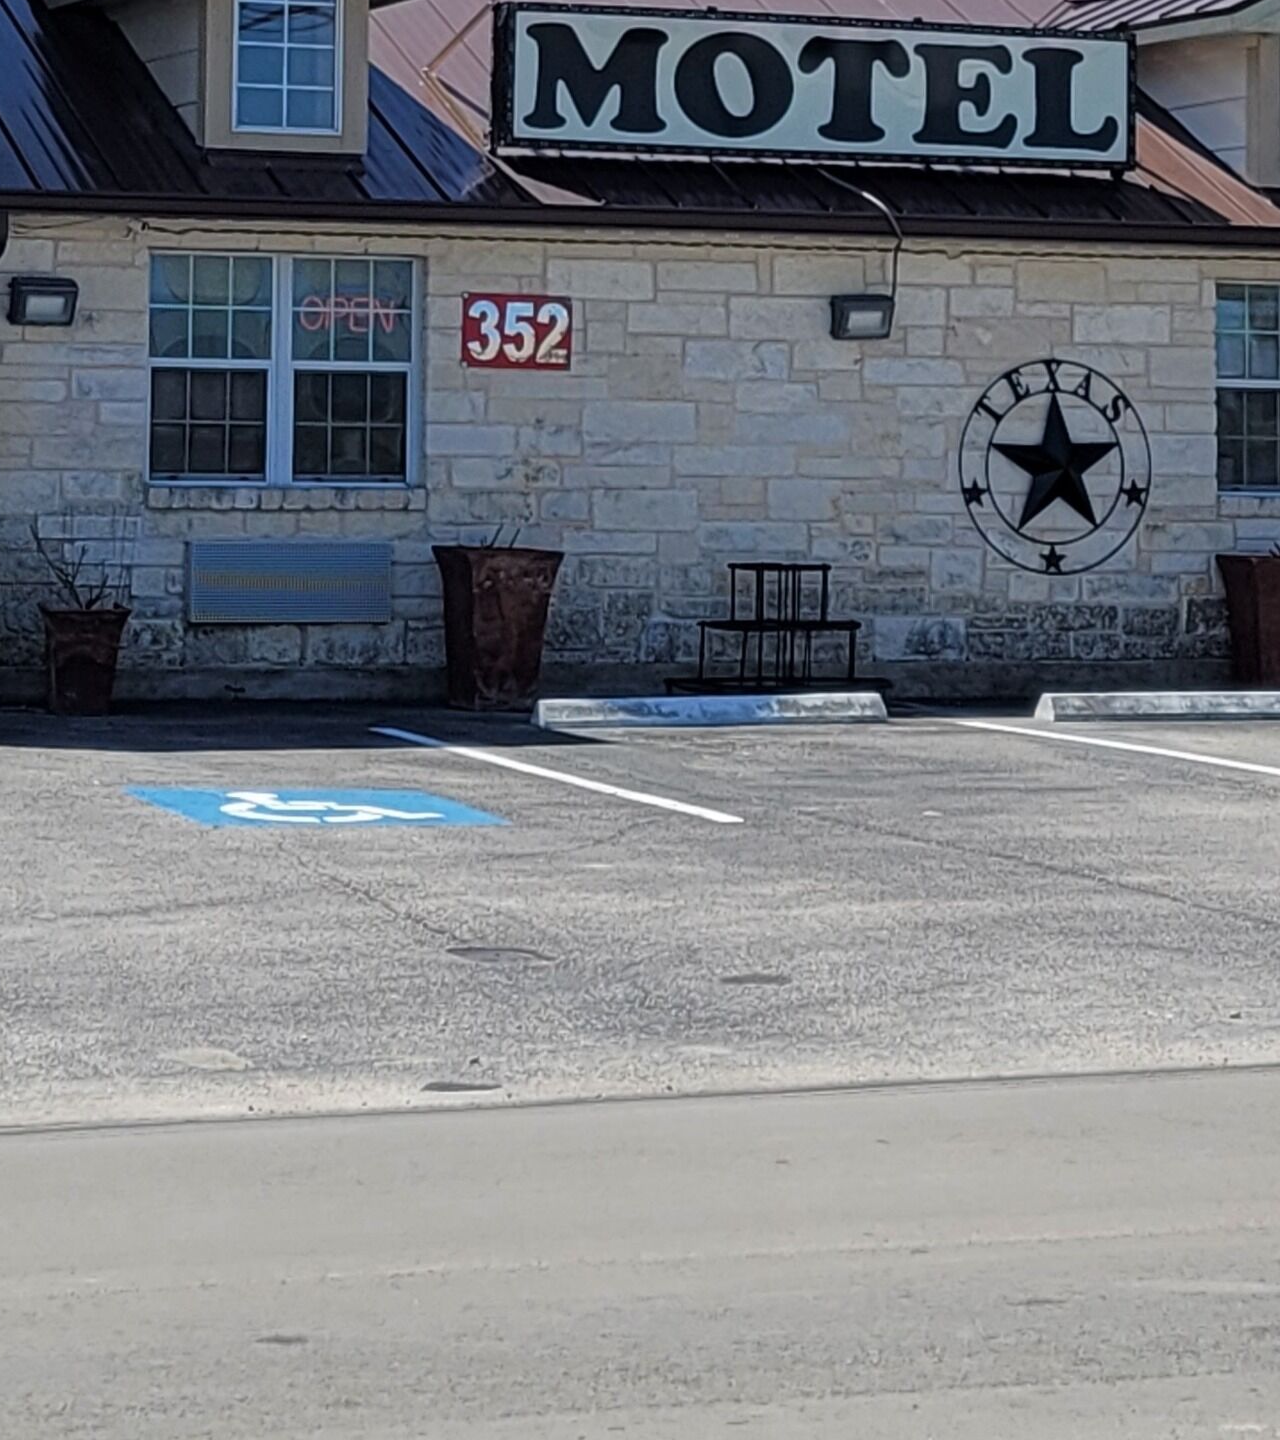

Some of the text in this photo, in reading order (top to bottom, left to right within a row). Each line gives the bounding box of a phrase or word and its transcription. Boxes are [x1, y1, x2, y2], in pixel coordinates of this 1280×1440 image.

[522, 21, 1119, 153] MOTEL
[300, 295, 395, 334] OPEN
[467, 300, 570, 364] 352
[974, 359, 1131, 424] TEXAS
